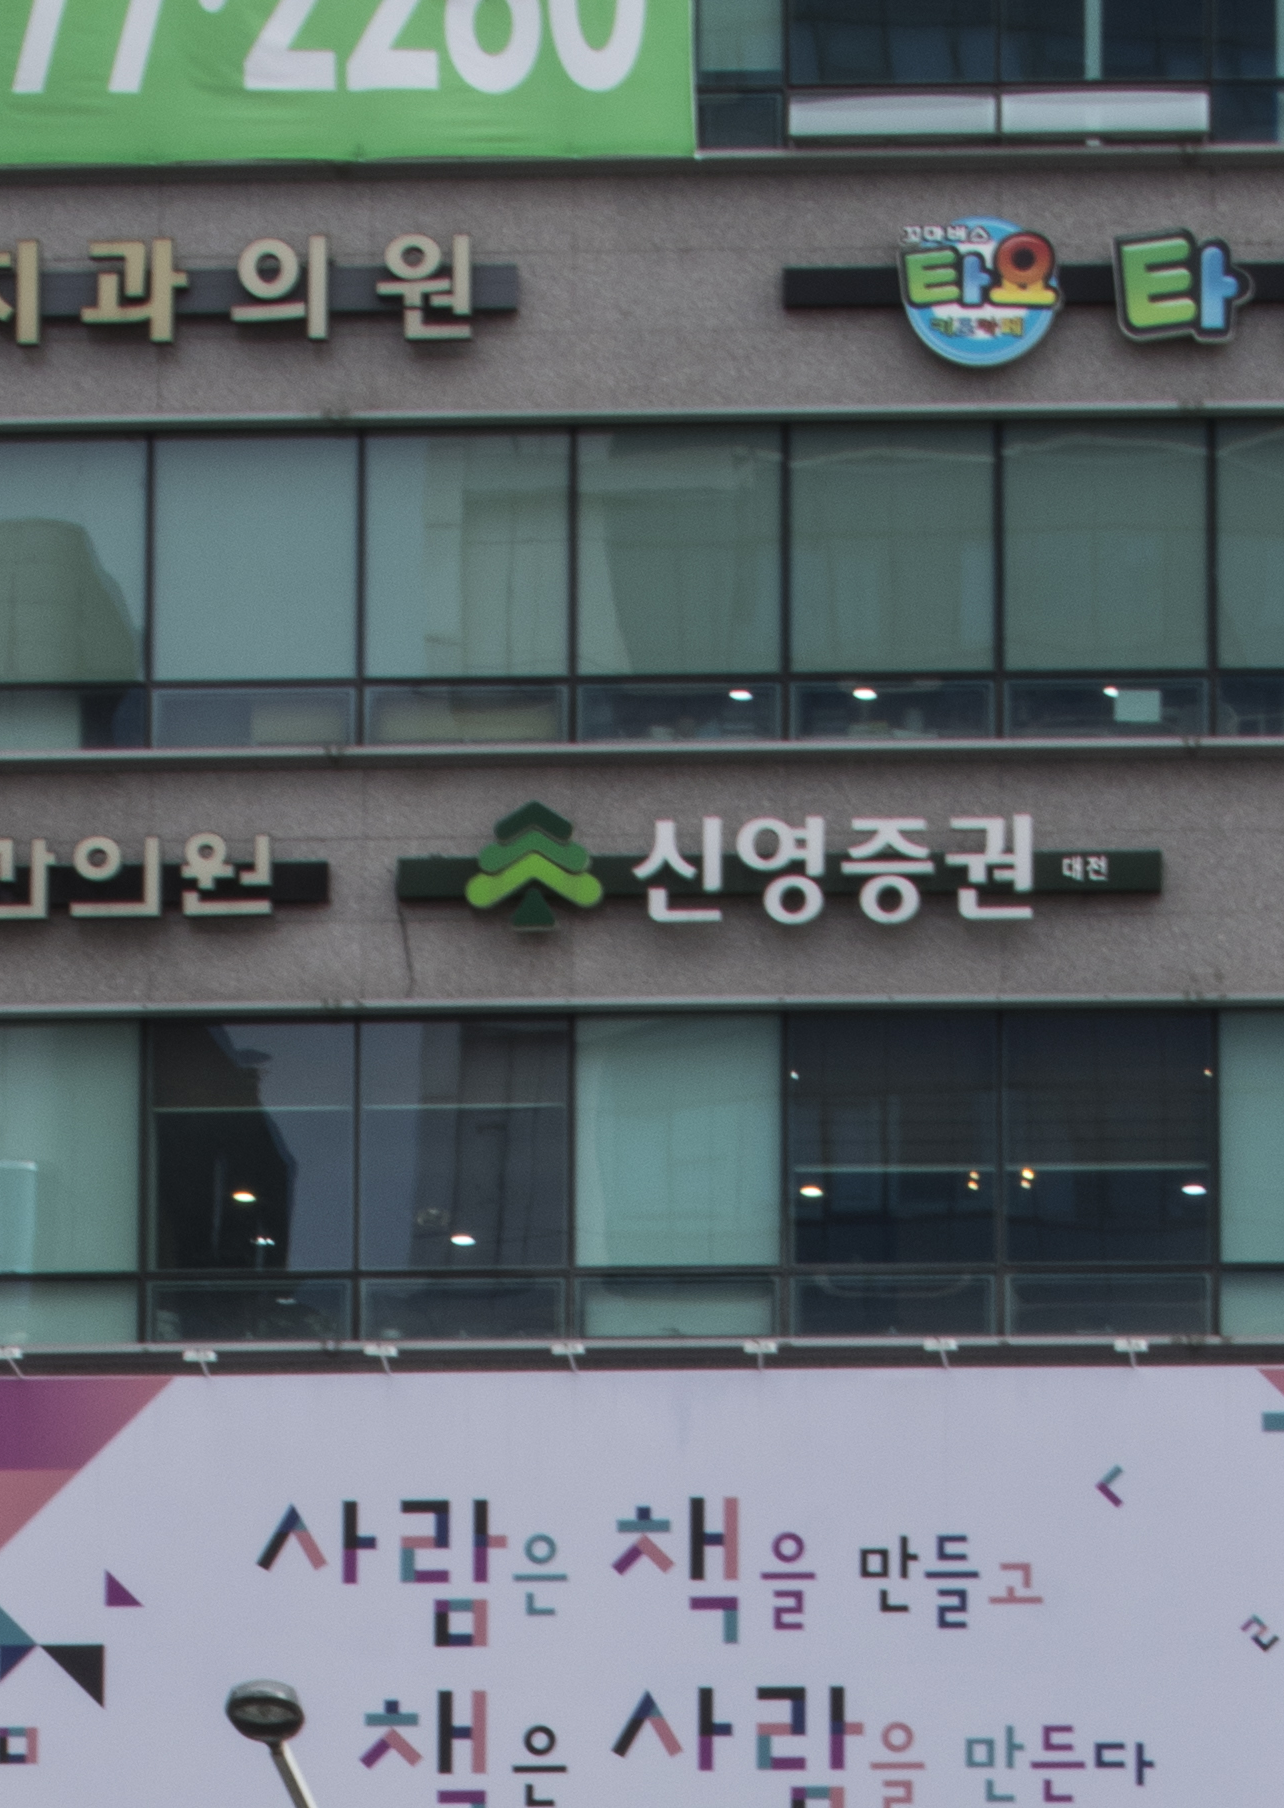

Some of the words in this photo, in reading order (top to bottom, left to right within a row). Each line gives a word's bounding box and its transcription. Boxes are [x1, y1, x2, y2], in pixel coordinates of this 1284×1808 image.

[905, 232, 1057, 306] 타요
[632, 814, 1035, 924] 신영증권
[1062, 855, 1109, 882] 대전
[256, 1499, 569, 1648] 사람은
[612, 1496, 817, 1644] 책을
[860, 1534, 1045, 1630] 만들고
[964, 1724, 1156, 1804] 만든다
